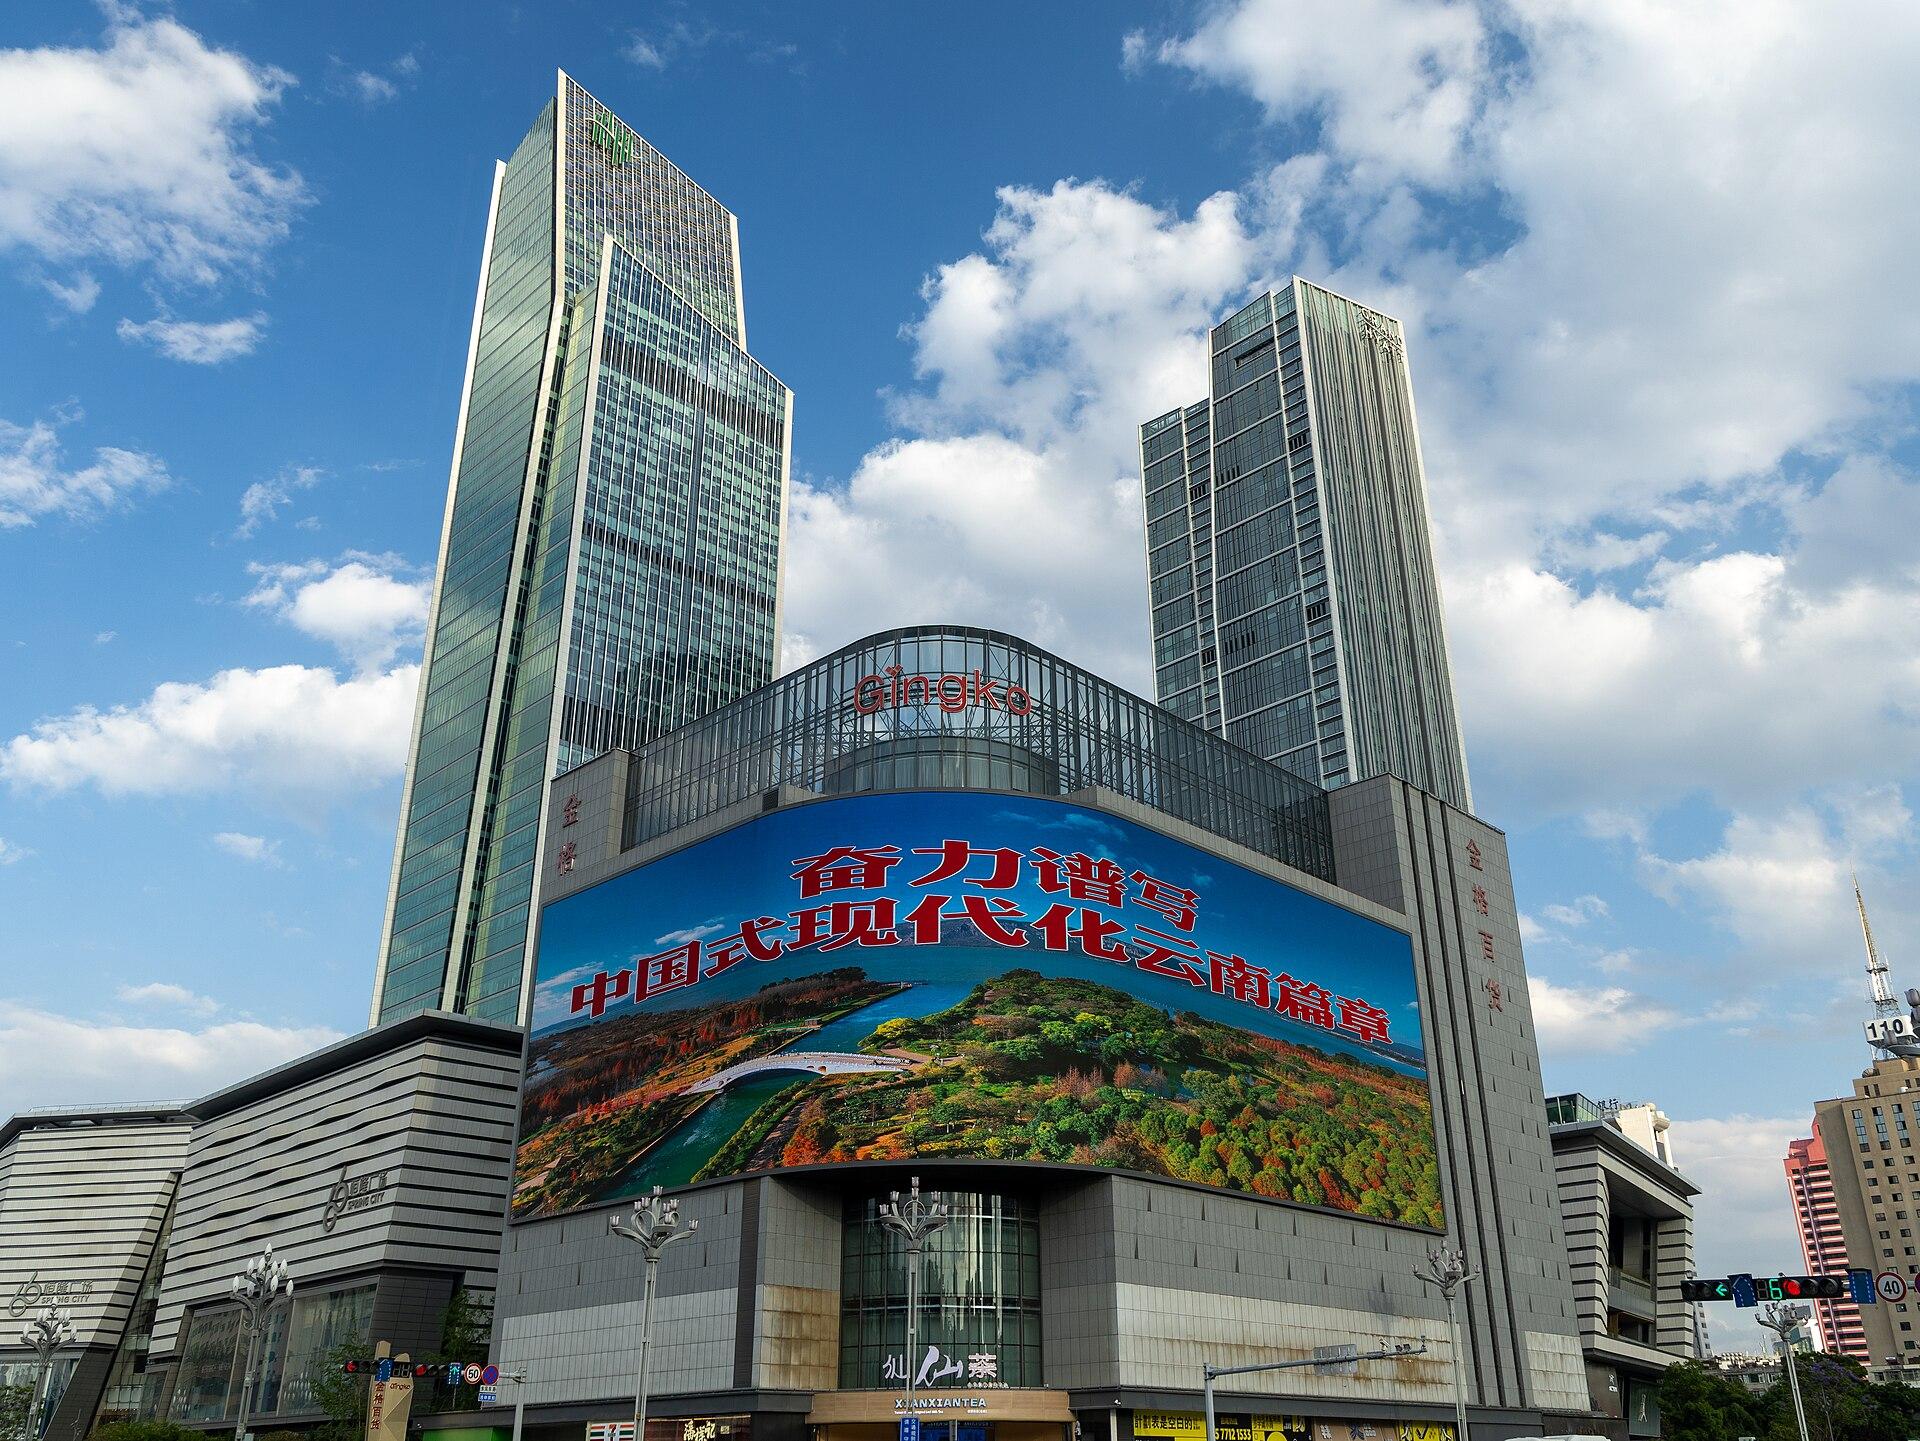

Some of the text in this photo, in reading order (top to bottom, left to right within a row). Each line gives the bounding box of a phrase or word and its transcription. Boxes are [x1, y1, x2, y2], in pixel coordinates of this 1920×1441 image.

[853, 664, 1032, 716] Gingko
[789, 839, 1201, 932] 奋力谱写
[1466, 839, 1503, 1012] 金格百货
[570, 894, 1393, 1045] 中国式现代化云南篇章
[1867, 1019, 1904, 1038] 110
[370, 1191, 386, 1204] CITY
[72, 1294, 91, 1304] CITY
[1883, 1280, 1901, 1295] 40
[468, 1369, 479, 1379] 50
[370, 1382, 386, 1430] 金格百货
